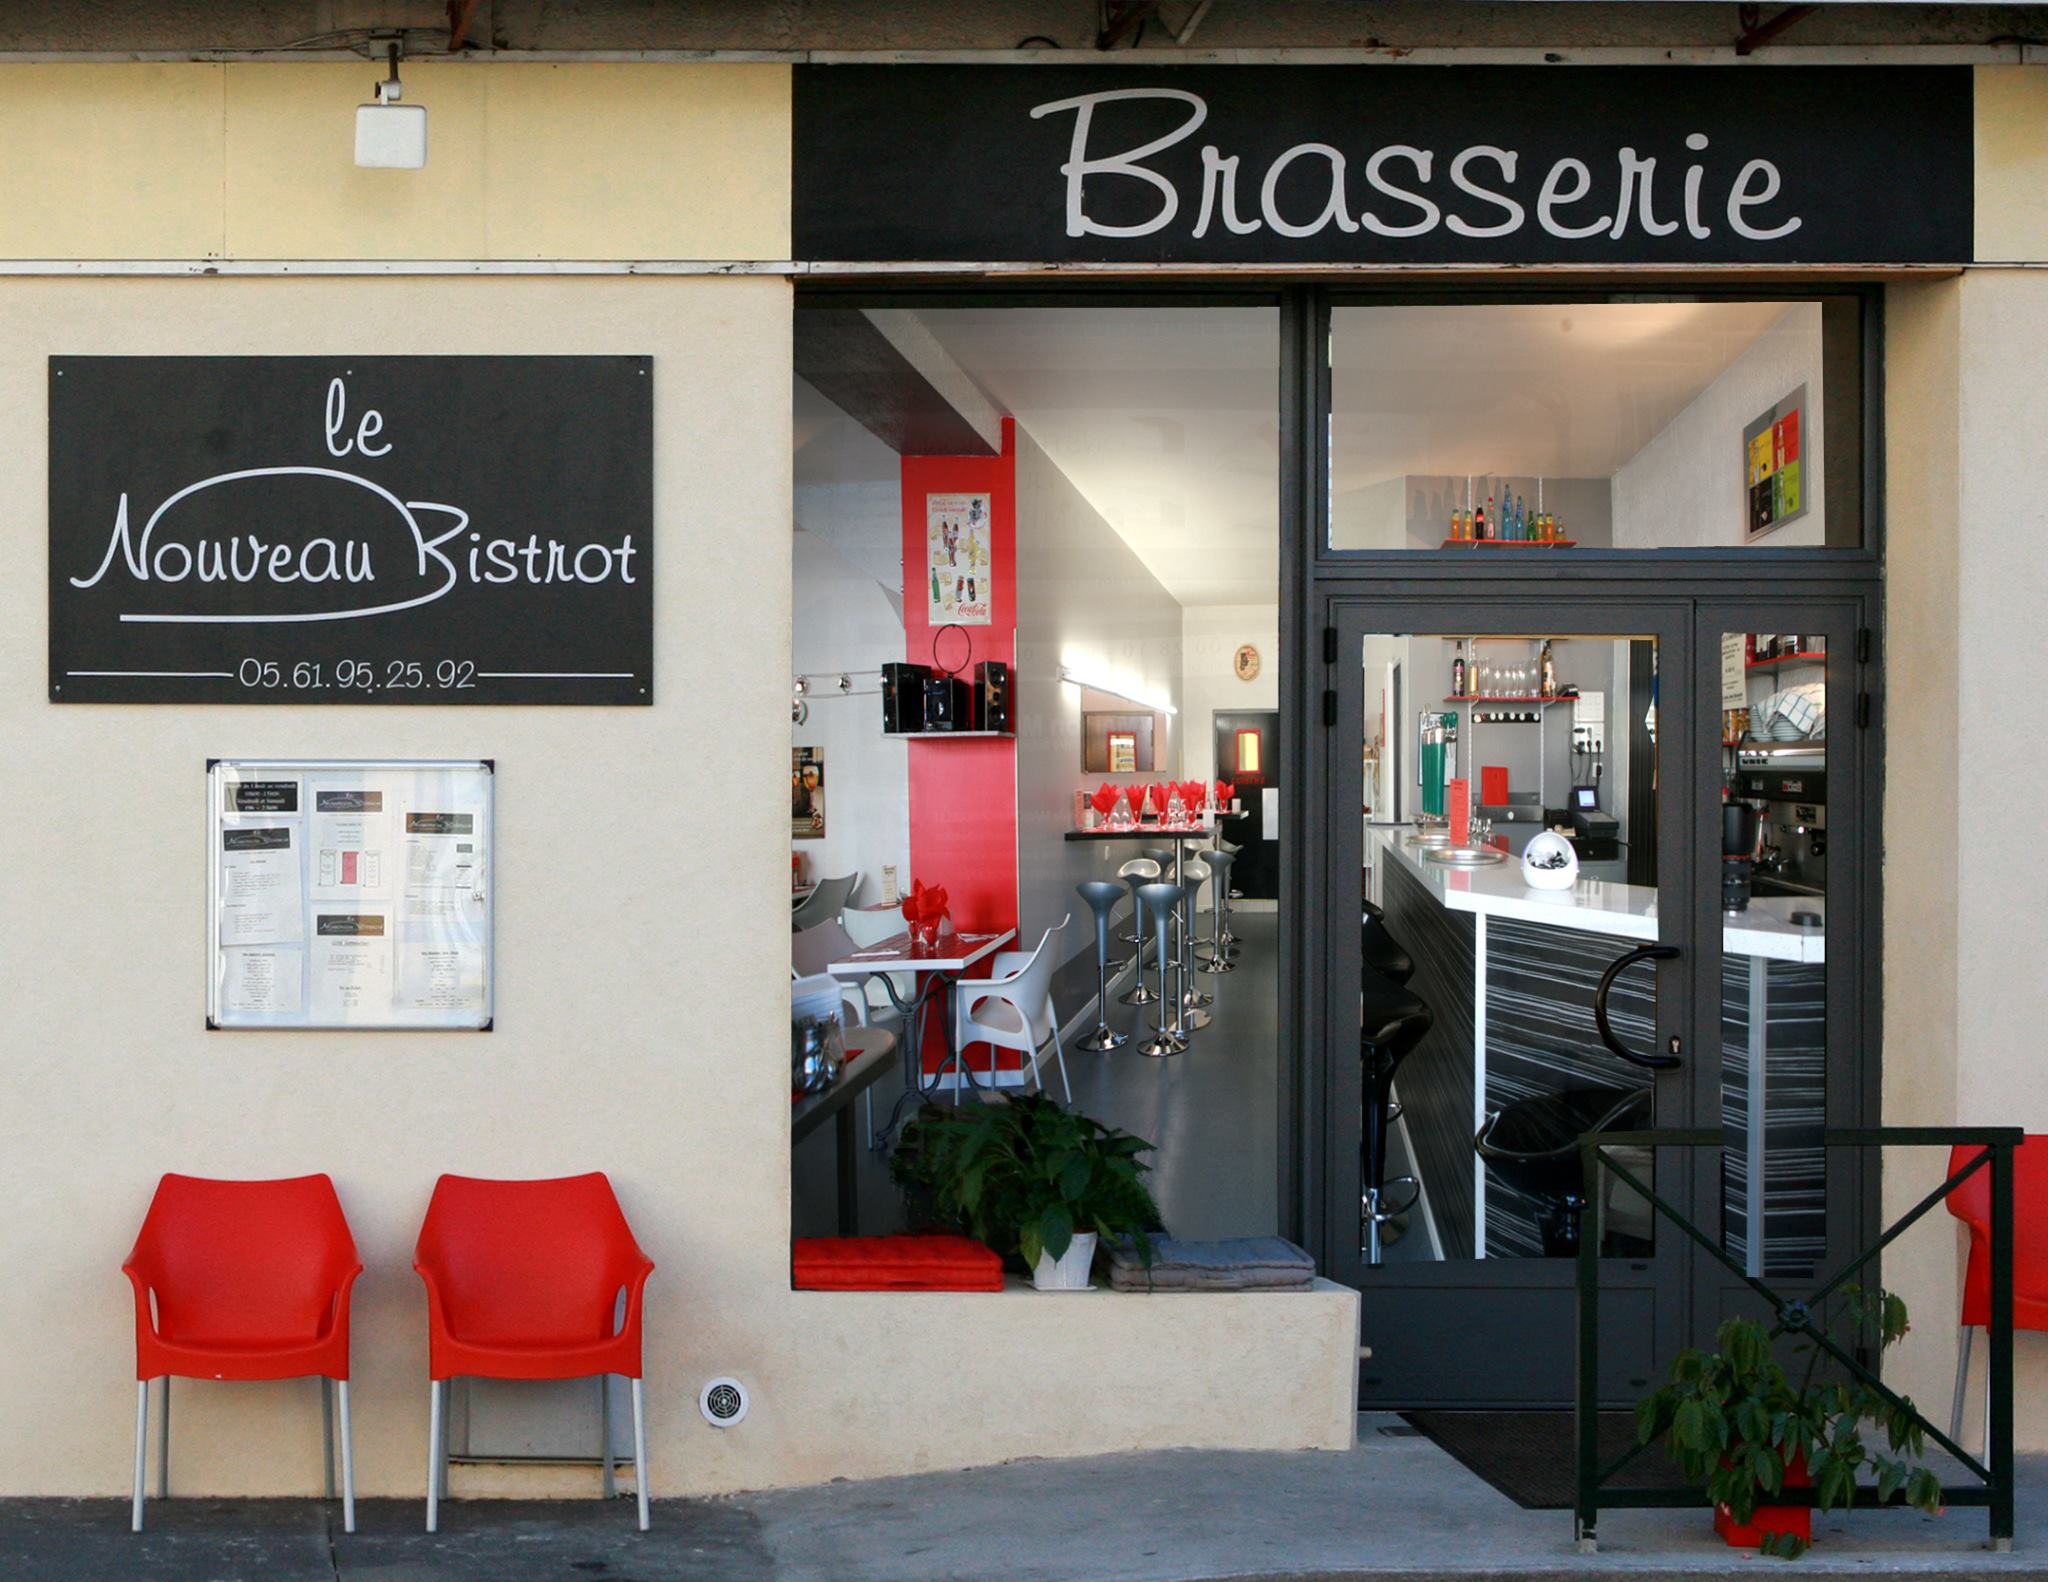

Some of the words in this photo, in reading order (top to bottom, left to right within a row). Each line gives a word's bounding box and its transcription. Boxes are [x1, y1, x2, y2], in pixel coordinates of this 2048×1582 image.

[1030, 88, 1802, 240] Brasserie
[325, 377, 393, 457] le
[69, 491, 377, 588] Nouveau
[404, 500, 637, 592] Bistrot
[239, 657, 476, 690] 05.61.95.25.92
